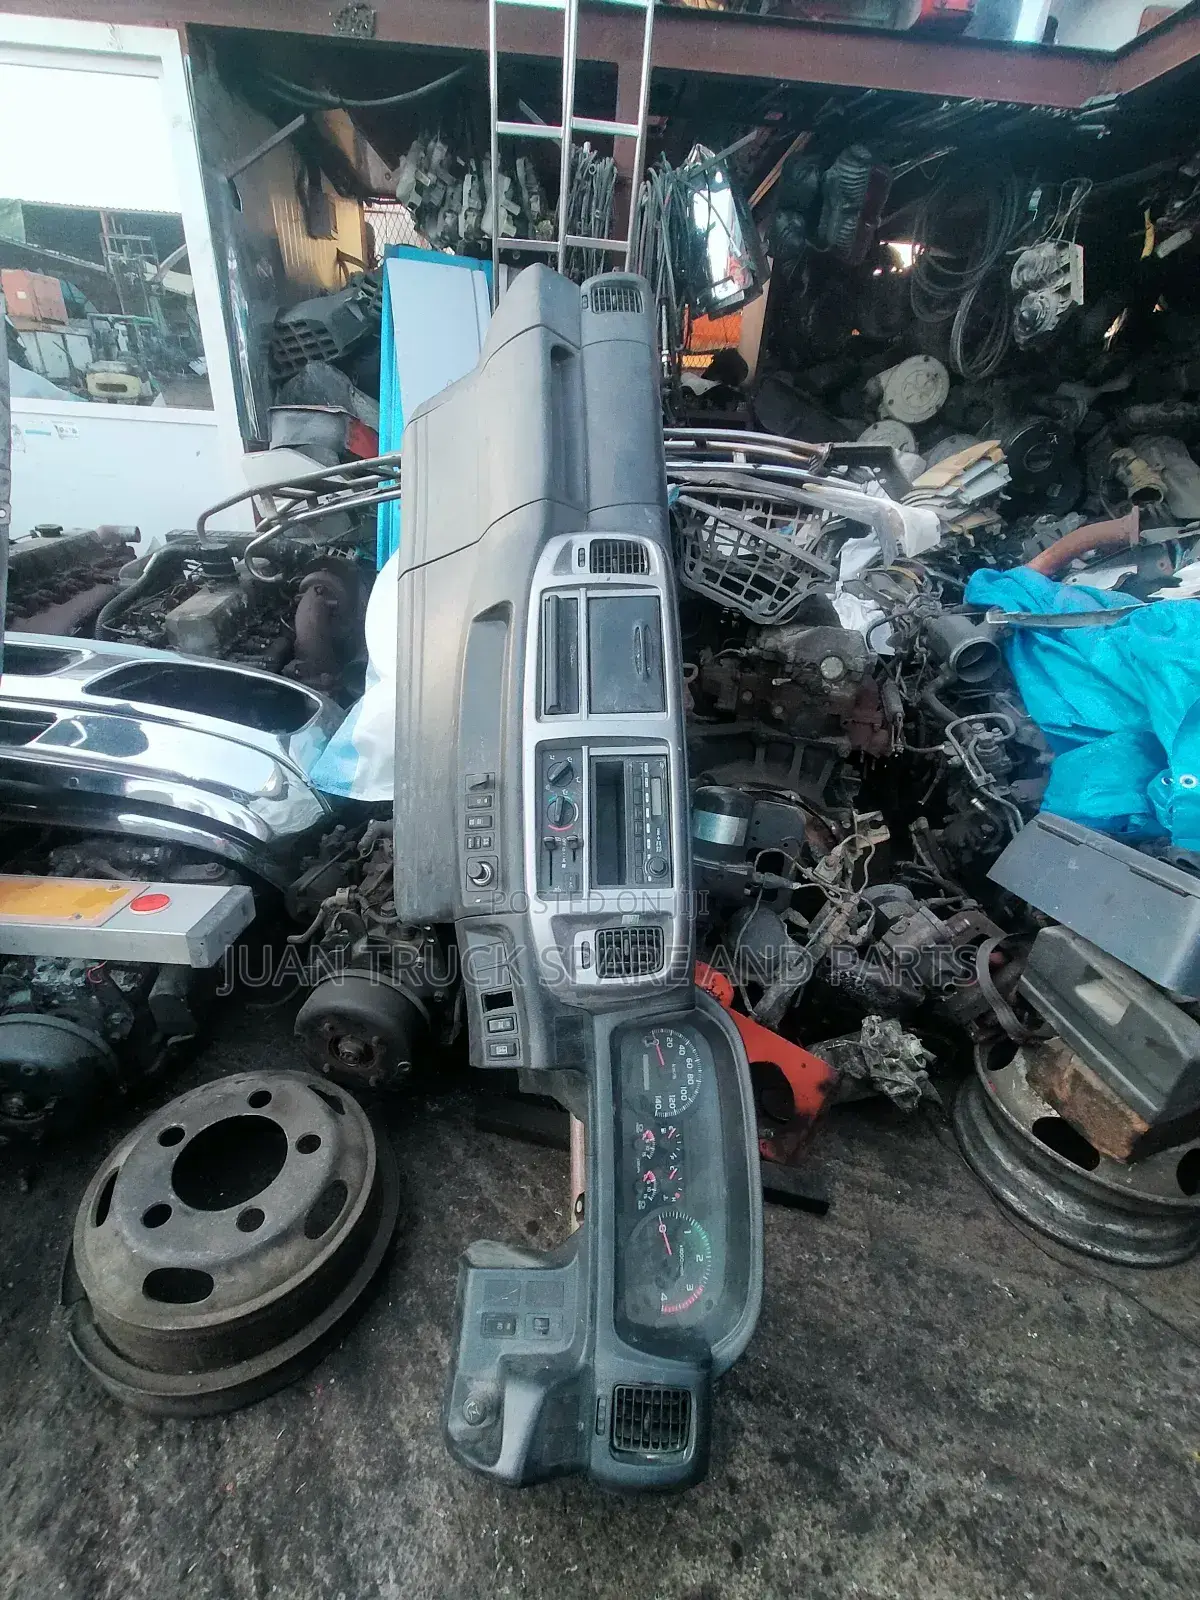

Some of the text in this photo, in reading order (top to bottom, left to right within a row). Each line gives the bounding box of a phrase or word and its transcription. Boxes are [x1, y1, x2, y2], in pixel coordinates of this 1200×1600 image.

[666, 1037, 673, 1048] 20
[679, 1044, 686, 1056] 40
[686, 1057, 693, 1069] 60
[687, 1073, 694, 1085] 80
[680, 1086, 688, 1101] 100
[696, 1254, 704, 1263] 2
[686, 1283, 694, 1291] 3
[660, 1292, 668, 1302] 4
